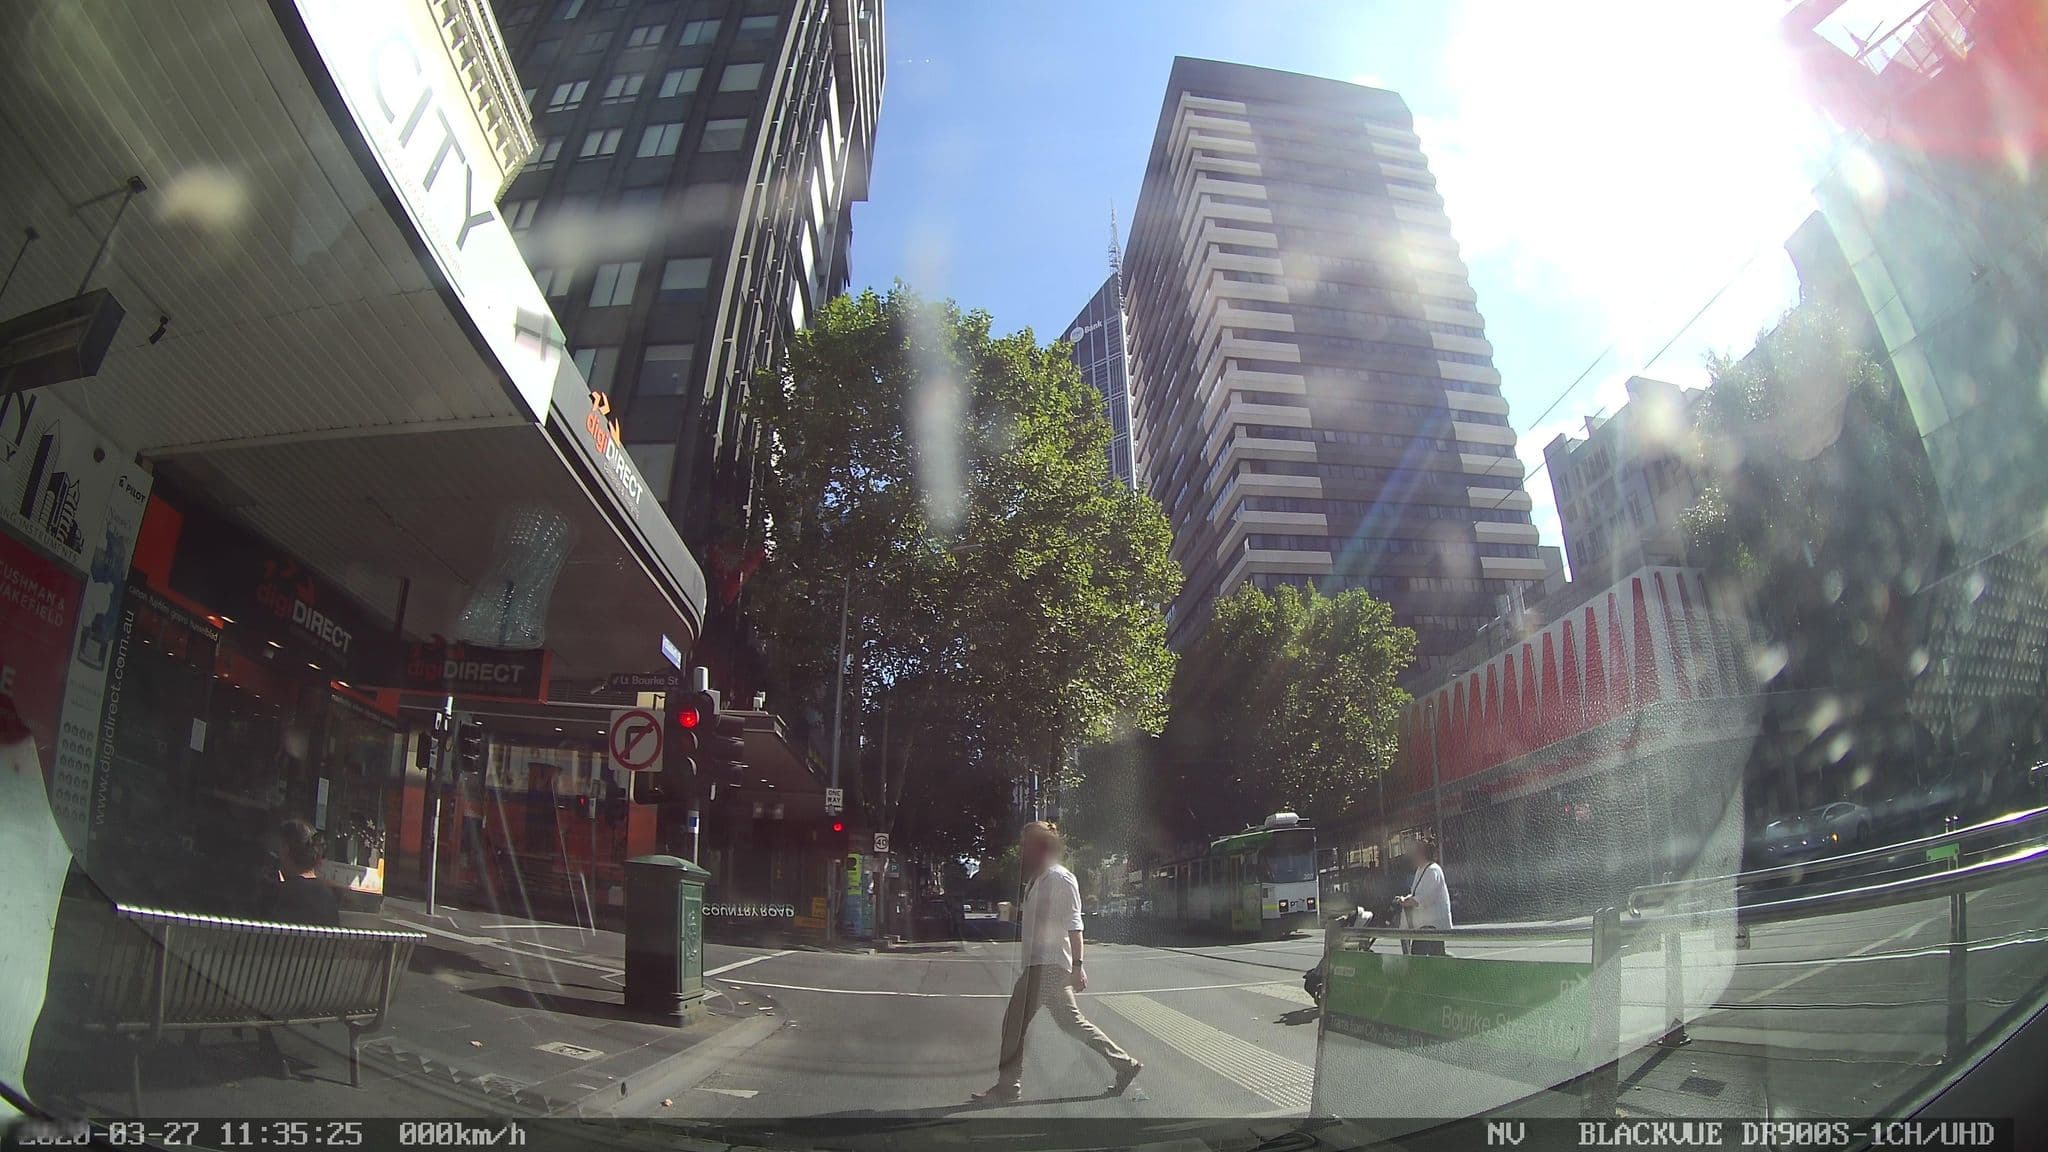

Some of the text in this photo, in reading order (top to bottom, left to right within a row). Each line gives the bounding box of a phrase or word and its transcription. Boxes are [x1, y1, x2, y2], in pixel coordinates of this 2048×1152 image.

[369, 36, 495, 250] CITY
[1084, 320, 1103, 334] Bank
[586, 411, 643, 504] digiDIRECT
[126, 484, 146, 503] PILOT
[632, 675, 665, 686] Bourke
[667, 675, 679, 686] St
[95, 609, 135, 825] www.digidirect.com.au
[828, 797, 841, 805] WAY
[876, 838, 887, 848] 40
[1441, 1004, 1490, 1034] Bourke
